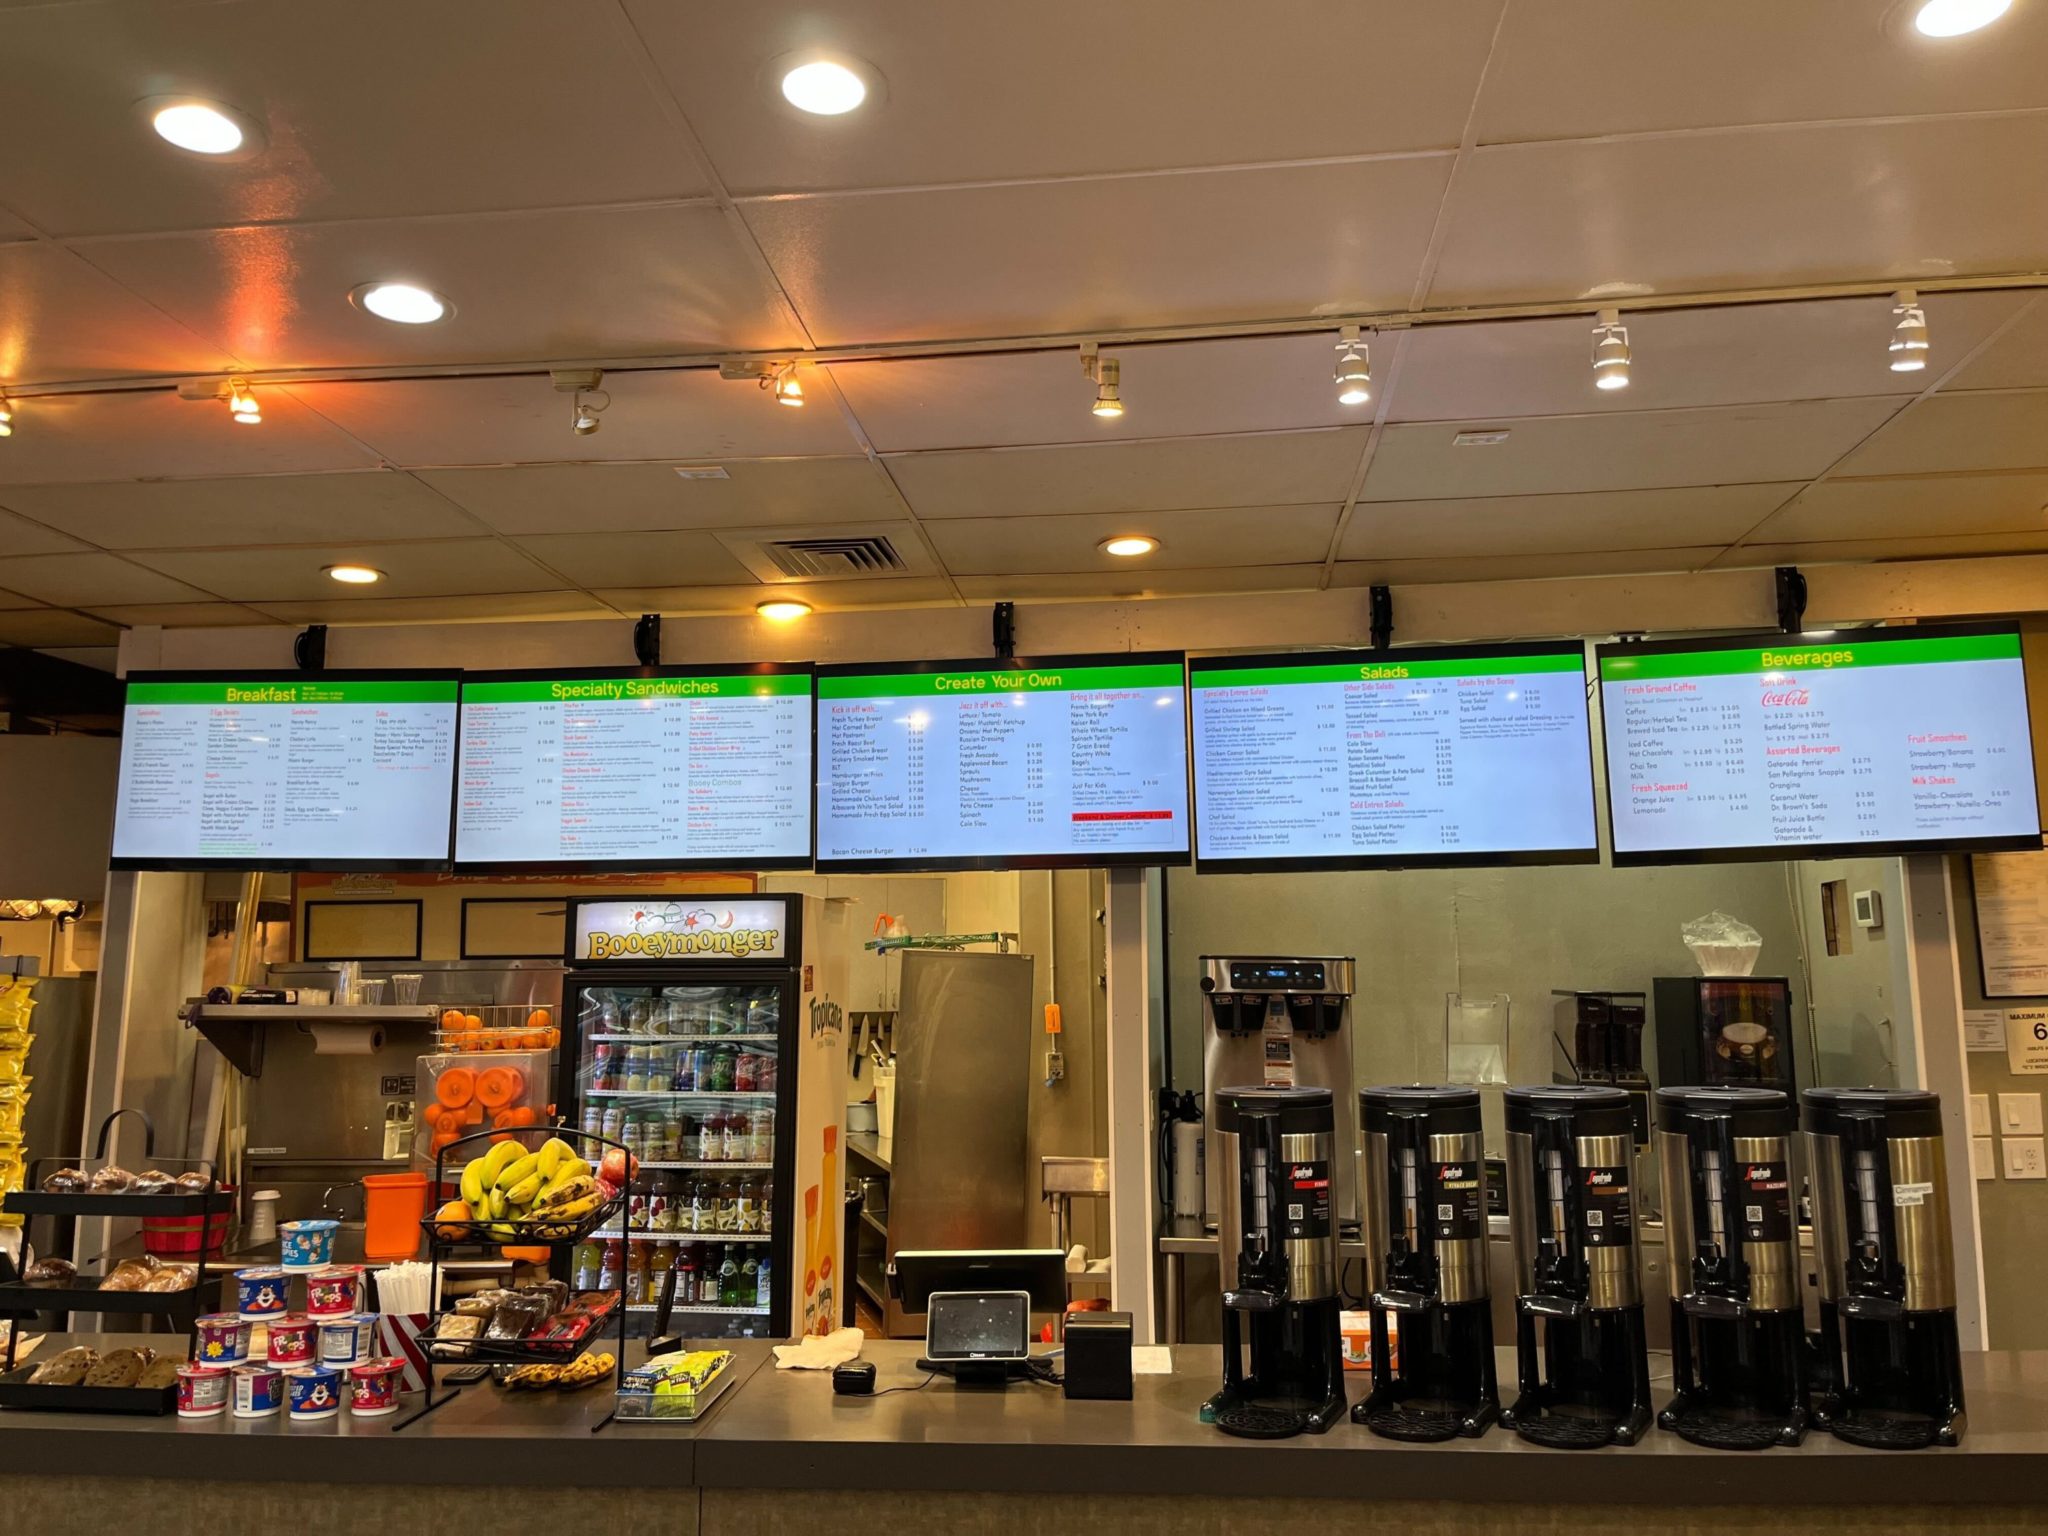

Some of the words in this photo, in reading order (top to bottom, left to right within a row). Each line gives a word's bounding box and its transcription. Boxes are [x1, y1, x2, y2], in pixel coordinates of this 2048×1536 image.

[1762, 650, 1854, 668] Beverages
[935, 676, 985, 690] Create
[992, 674, 1025, 688] Your
[1028, 673, 1062, 687] Own
[1360, 666, 1409, 680] Salads
[226, 687, 296, 702] Breakfast
[552, 682, 622, 700] Specialty
[626, 681, 719, 695] Sandwiches
[1624, 686, 1644, 694] Fresh
[1646, 684, 1671, 693] Ground
[1674, 683, 1696, 692] Coffee
[1766, 747, 1799, 755] Assorted
[1802, 746, 1840, 754] Beverages
[588, 928, 779, 959] Booeymonger
[809, 992, 842, 1038] Tropicana
